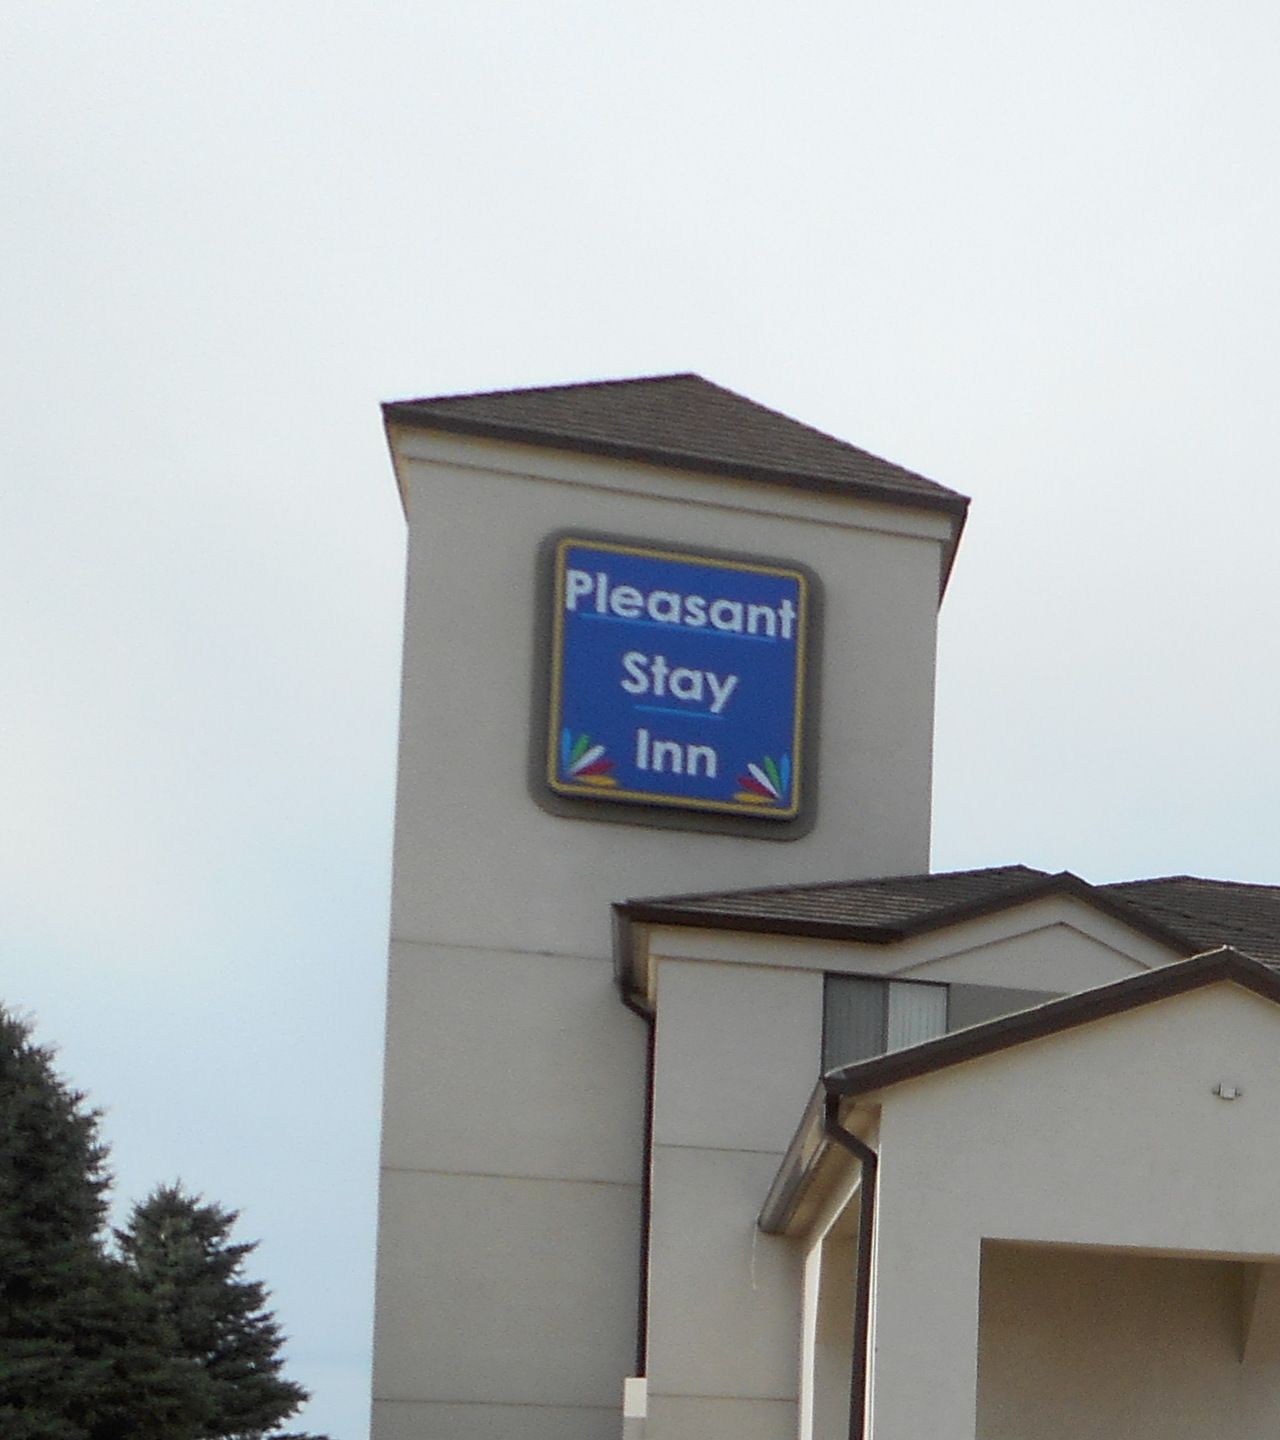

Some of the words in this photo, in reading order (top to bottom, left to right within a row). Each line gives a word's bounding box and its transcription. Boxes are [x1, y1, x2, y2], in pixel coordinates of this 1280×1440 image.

[565, 569, 796, 639] Pleasant
[620, 651, 738, 713] Stay
[636, 728, 717, 778] Inn
